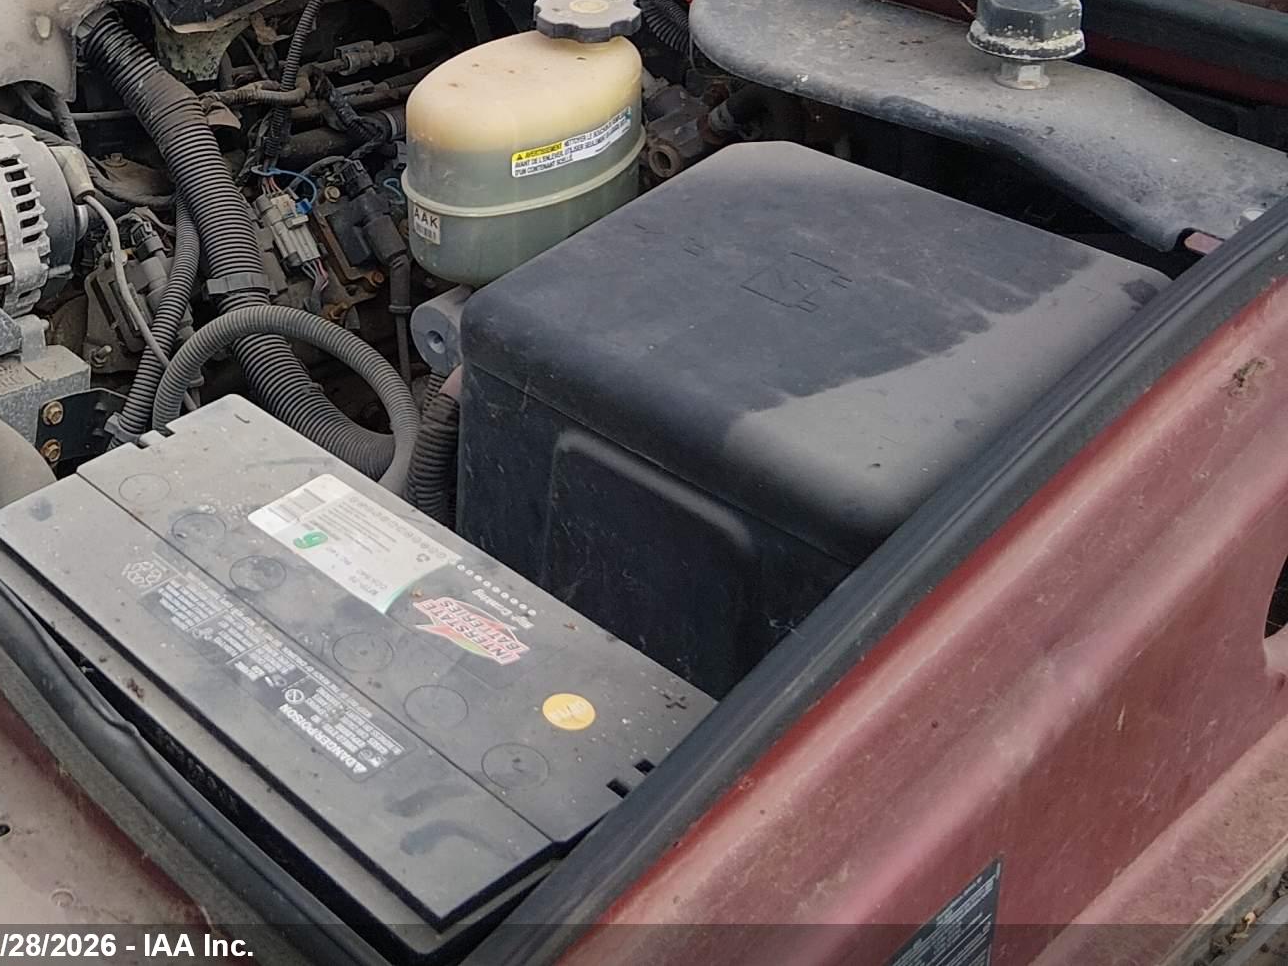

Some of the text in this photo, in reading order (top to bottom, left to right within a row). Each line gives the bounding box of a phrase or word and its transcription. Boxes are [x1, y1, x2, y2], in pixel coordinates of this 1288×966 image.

[414, 208, 438, 229] AAK
[422, 602, 513, 660] INTERSTATE
[440, 600, 520, 650] BATTERIES
